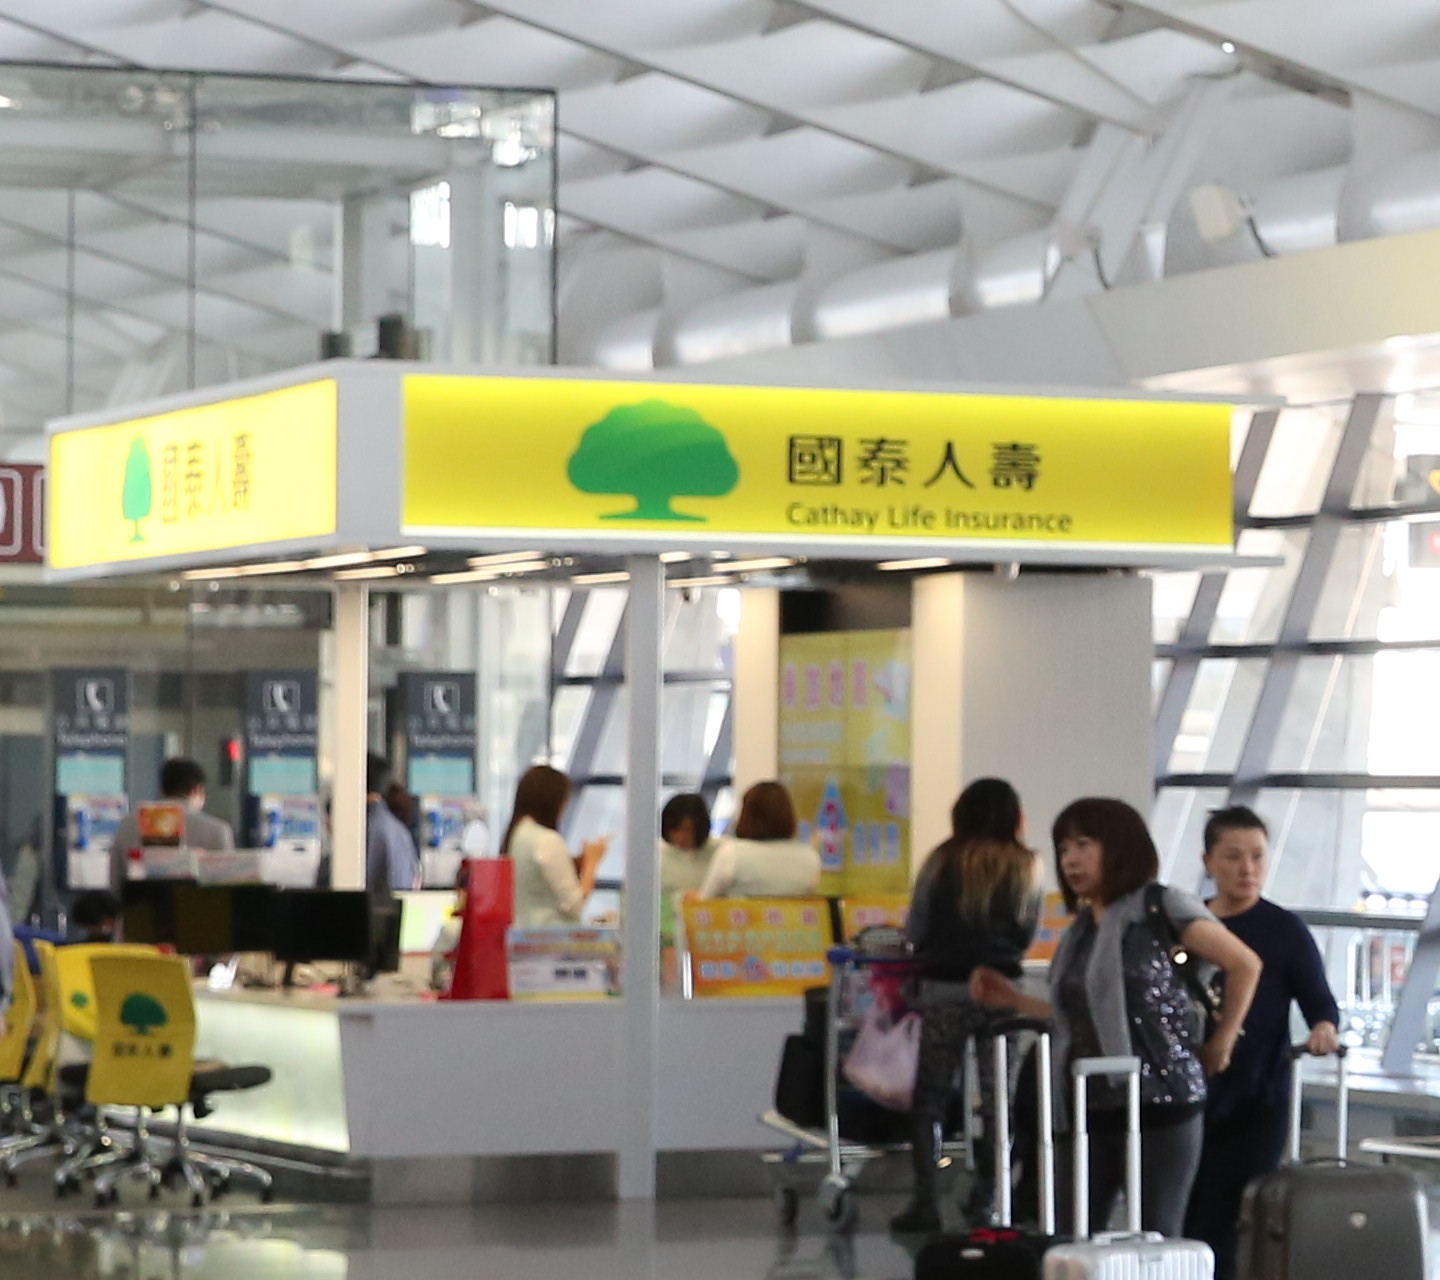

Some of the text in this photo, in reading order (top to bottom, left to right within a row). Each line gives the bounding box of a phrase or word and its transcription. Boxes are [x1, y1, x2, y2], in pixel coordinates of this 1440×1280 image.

[788, 433, 1041, 491] 國泰人壽
[786, 501, 1073, 534] Cathay Life Insurance
